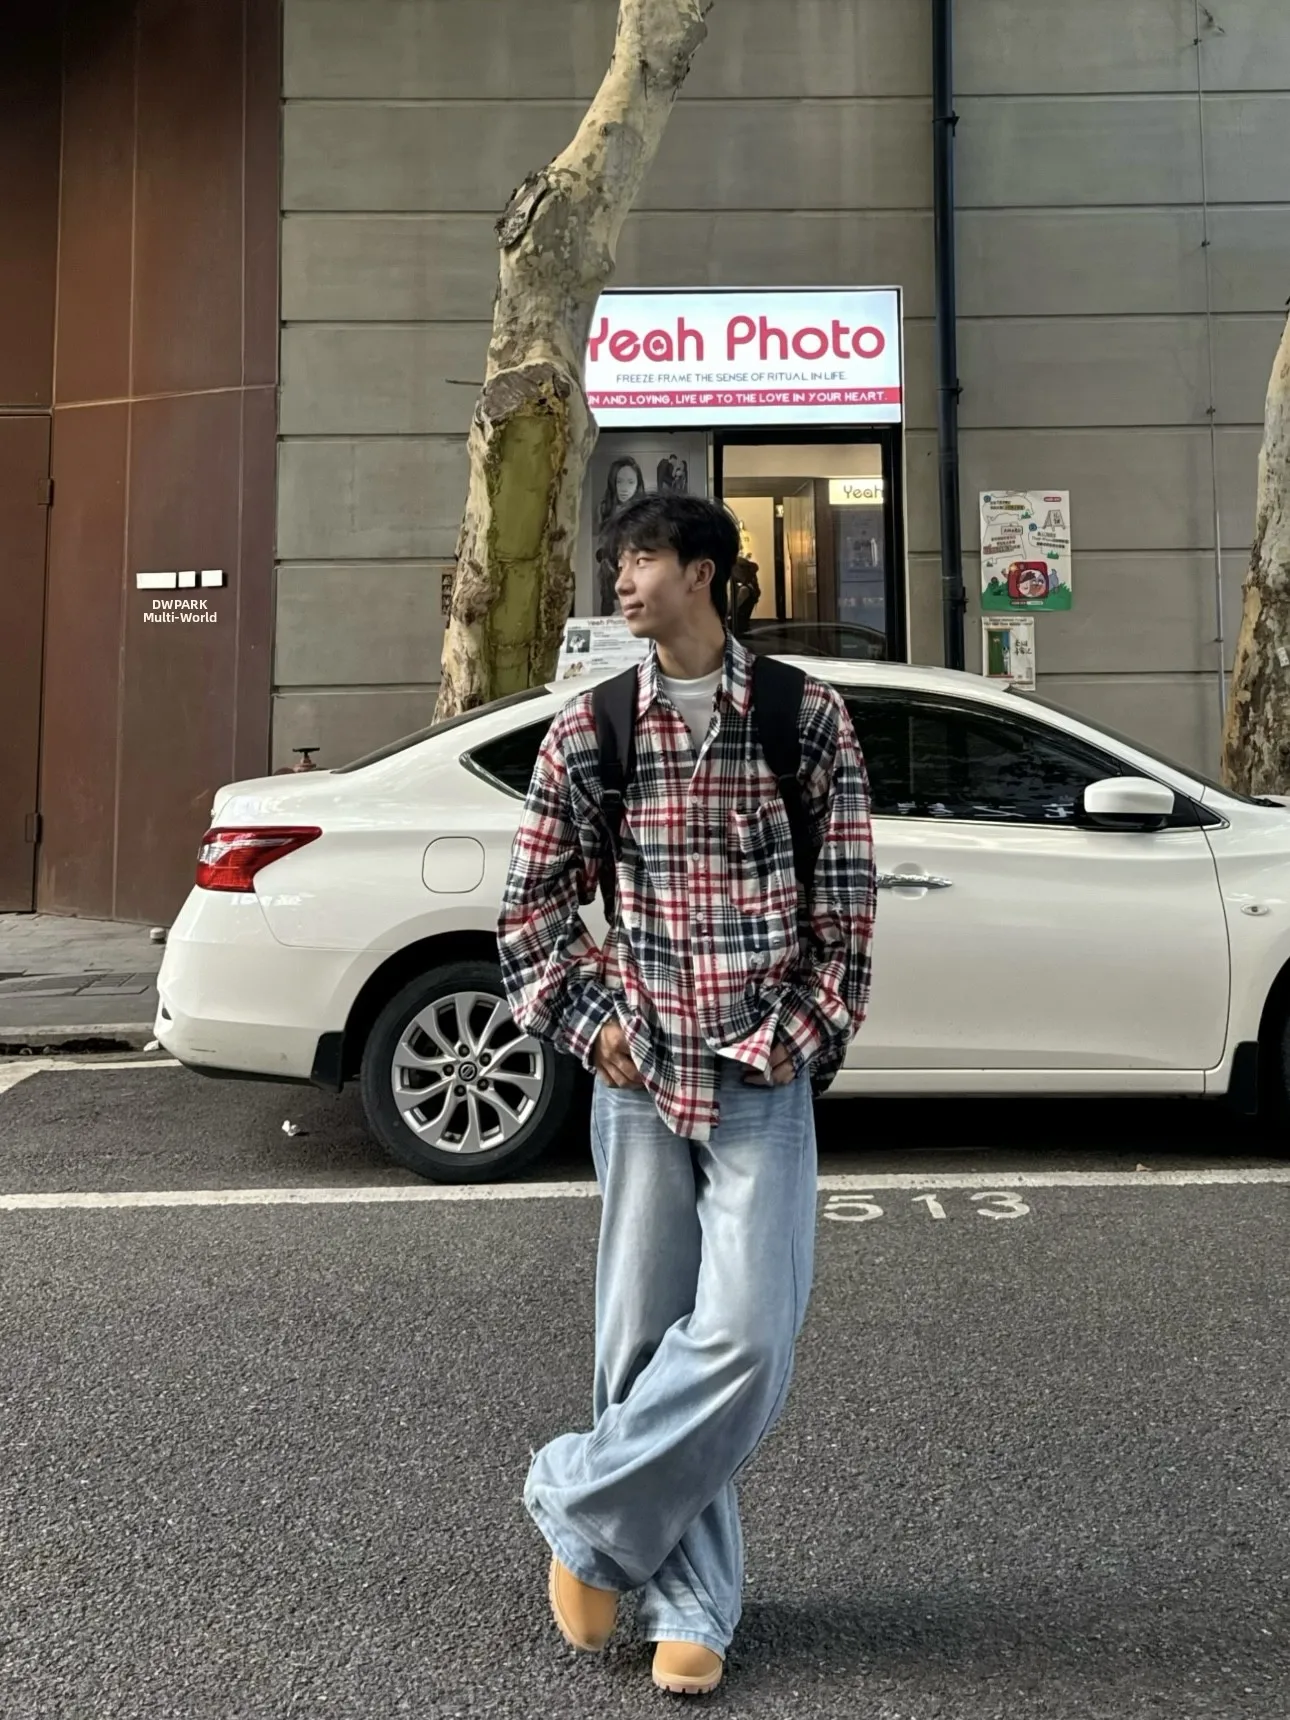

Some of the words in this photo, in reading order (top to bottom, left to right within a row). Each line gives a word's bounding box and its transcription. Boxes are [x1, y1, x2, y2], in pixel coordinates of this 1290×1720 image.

[588, 316, 704, 362] Yeah
[726, 315, 885, 361] Photo
[616, 374, 654, 384] FREEZE
[658, 373, 692, 383] FRAME
[695, 373, 713, 382] THE
[716, 372, 748, 382] SENSE
[751, 371, 764, 381] OF
[767, 371, 808, 381] RITUAL
[811, 371, 822, 380] IN
[602, 394, 627, 405] AND
[630, 394, 674, 405] LOVING,
[676, 393, 697, 404] LIVE
[699, 393, 713, 403] UP
[716, 393, 733, 403] TO
[736, 393, 757, 403] THE
[759, 393, 789, 403] LOVE
[793, 392, 805, 402] IN
[808, 392, 841, 402] YOUR
[143, 612, 217, 623] Multi-World
